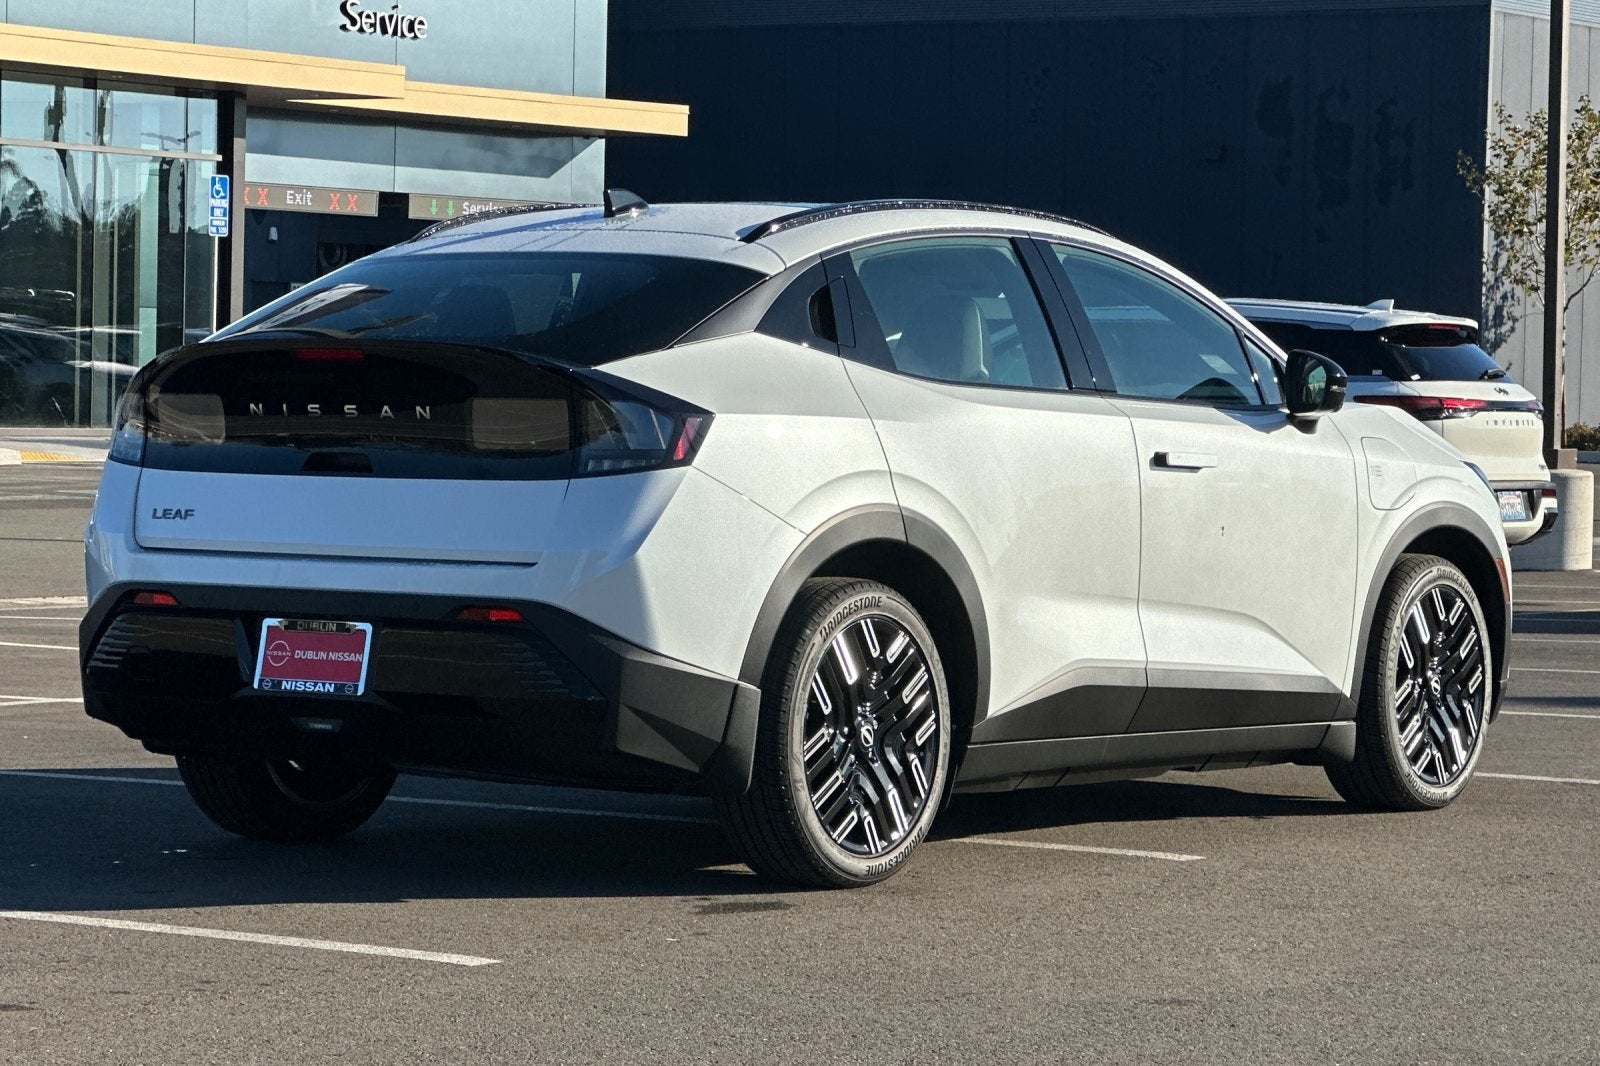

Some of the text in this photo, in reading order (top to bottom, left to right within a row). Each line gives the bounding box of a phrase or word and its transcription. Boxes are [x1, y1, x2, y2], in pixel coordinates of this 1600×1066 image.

[339, 0, 428, 39] Service
[286, 189, 312, 206] Exit
[249, 402, 432, 420] NISSAN
[151, 507, 196, 521] LEAF
[297, 621, 337, 632] DUBLIN
[819, 595, 883, 644] BRIDGESTONE
[294, 650, 363, 662] DUBLIN NISSAN
[281, 680, 335, 693] NISSAN
[863, 825, 925, 877] BRIDGESTONE
